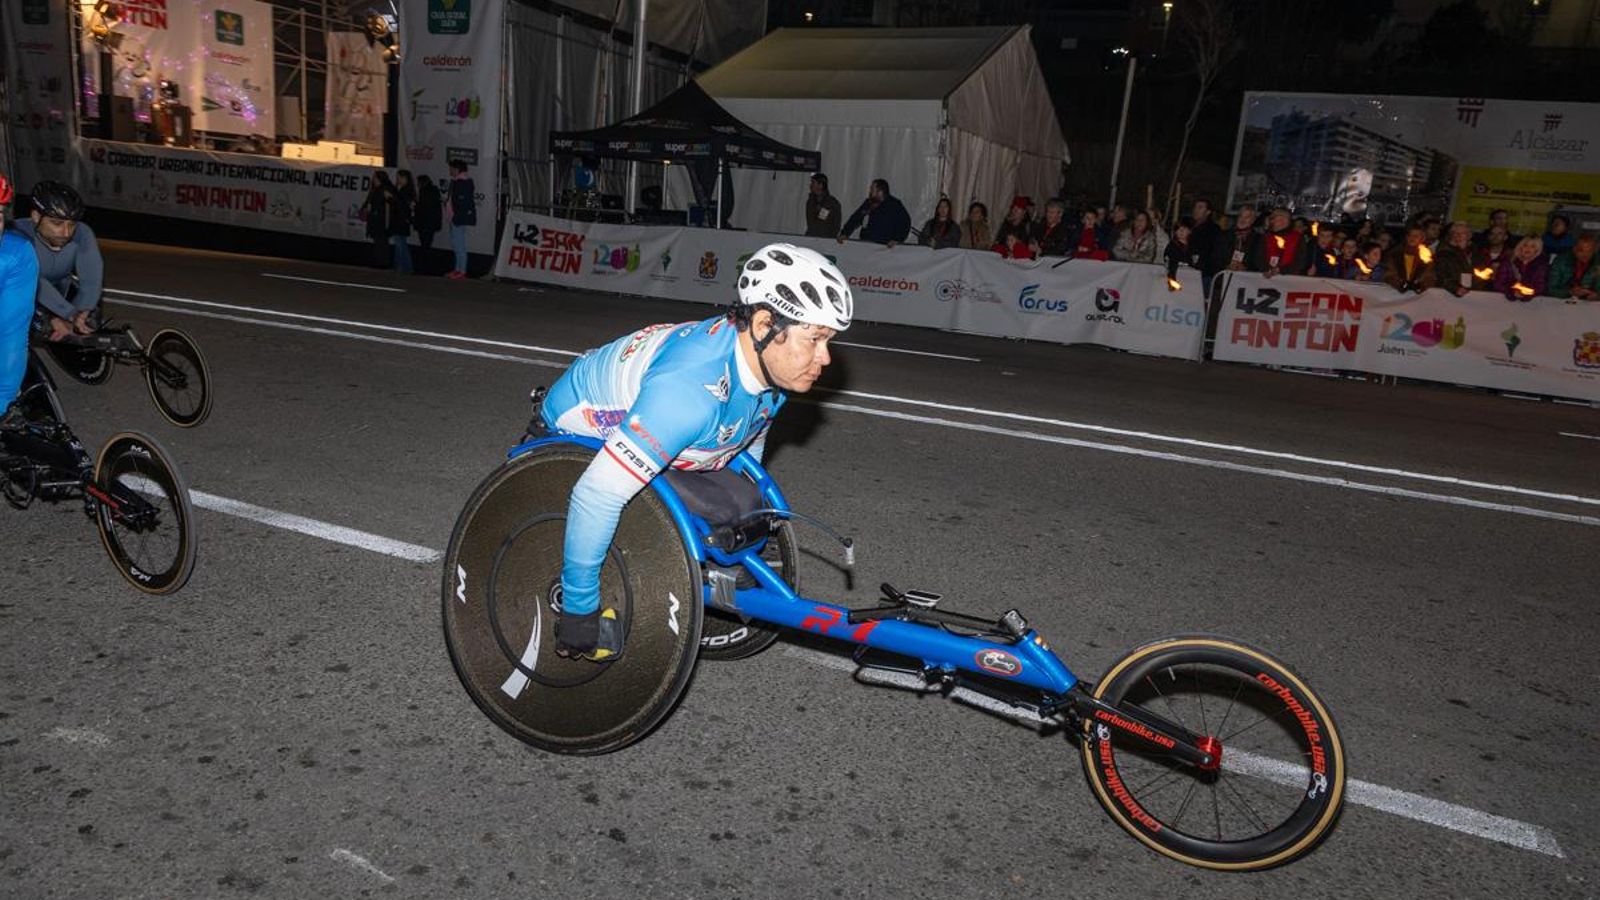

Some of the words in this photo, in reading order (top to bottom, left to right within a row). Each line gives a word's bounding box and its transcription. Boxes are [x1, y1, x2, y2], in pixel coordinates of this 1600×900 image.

[1505, 129, 1589, 151] Alcázar
[159, 157, 204, 173] URBANA
[206, 161, 310, 185] INTERNACIONAL
[313, 171, 359, 191] NOCHE
[361, 176, 371, 191] D
[176, 184, 209, 207] SAN
[514, 223, 540, 245] 42
[541, 228, 585, 252] SAN
[848, 275, 920, 292] calderón
[764, 292, 805, 317] catlike
[1018, 284, 1069, 312] Forus
[1235, 287, 1282, 315] 42
[1284, 291, 1363, 321] SAN
[1144, 304, 1200, 327] alsa
[1095, 709, 1177, 750] carbonbike.usa
[1256, 672, 1327, 775] carbonbike.usa
[1099, 740, 1163, 833] carbonbike.usa
